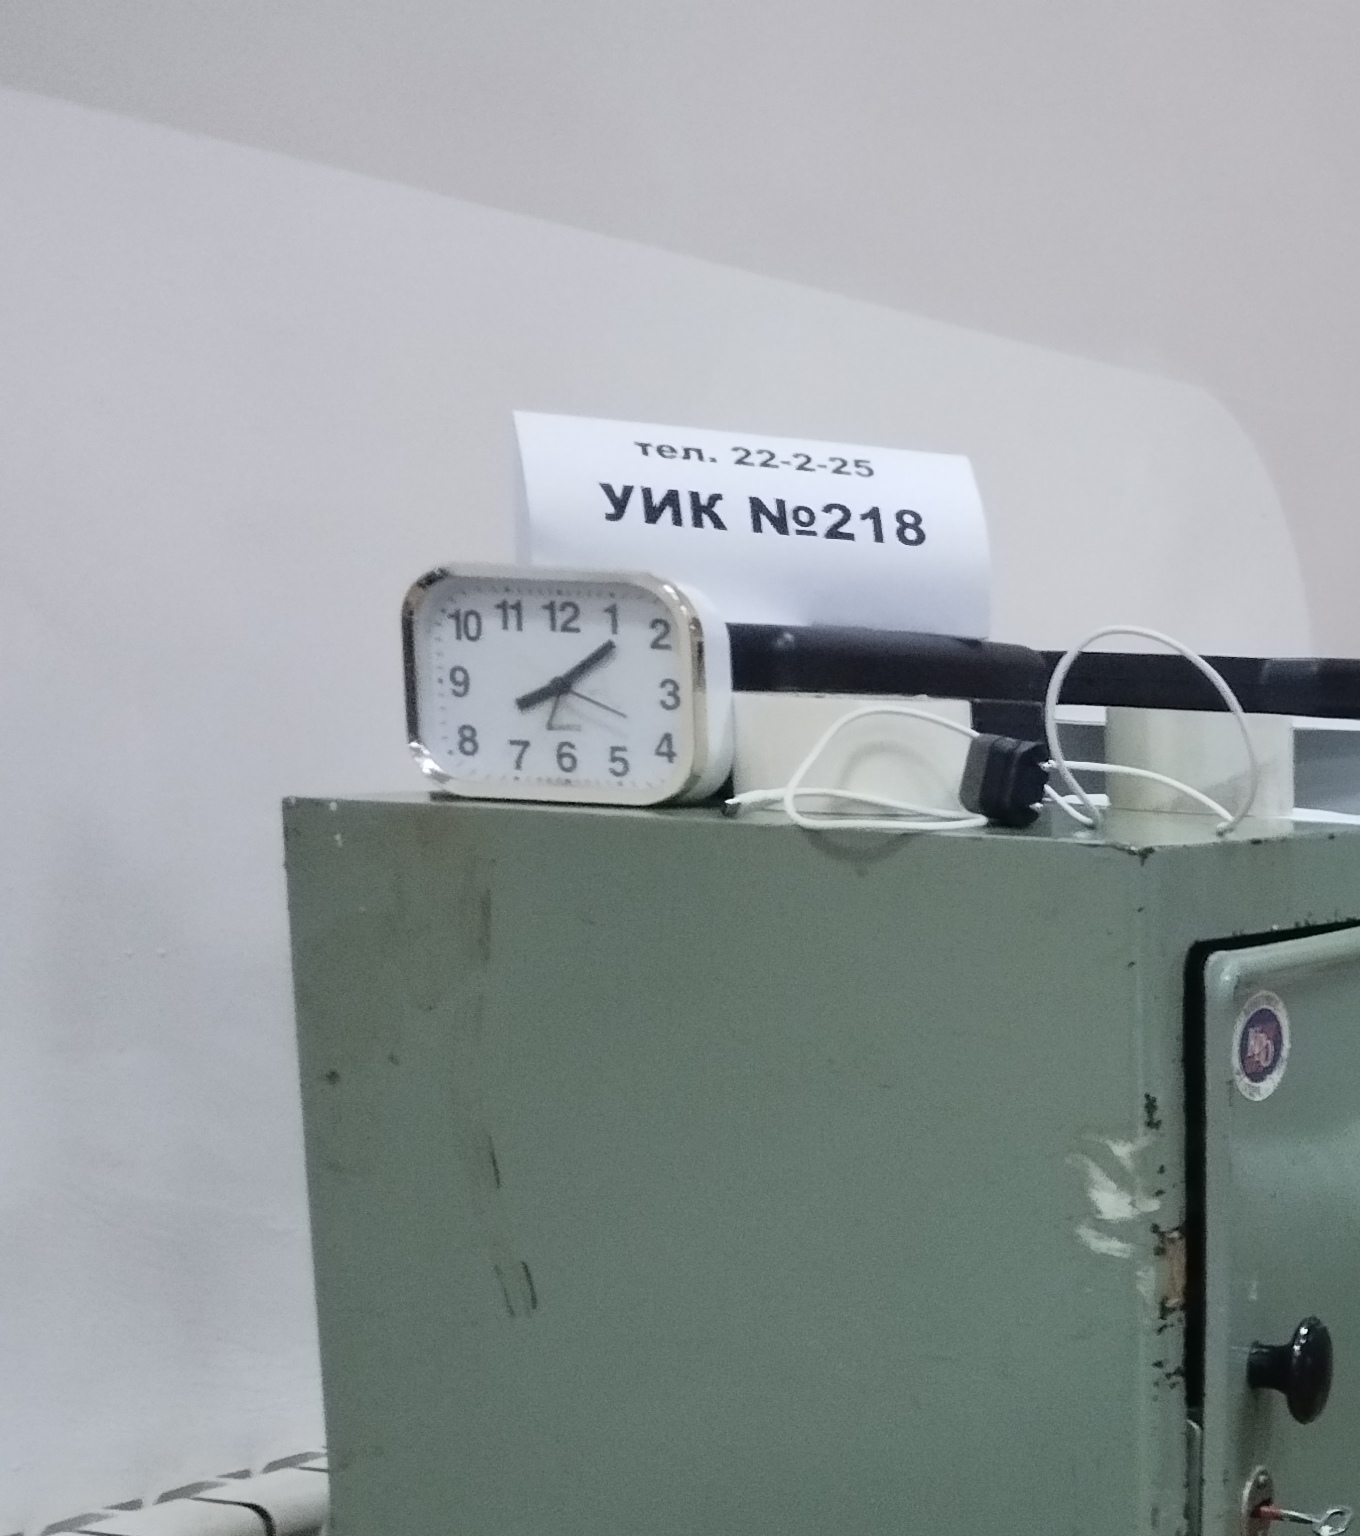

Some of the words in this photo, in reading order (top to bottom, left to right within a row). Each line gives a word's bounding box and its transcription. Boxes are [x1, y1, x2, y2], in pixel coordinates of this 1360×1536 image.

[634, 441, 718, 463] тел.
[731, 446, 875, 478] 22-2-25
[599, 482, 728, 531] УИК
[749, 496, 927, 547] №218
[448, 609, 482, 641] 10
[495, 599, 523, 632] 11
[542, 601, 581, 633] 12
[604, 604, 619, 635] 1
[650, 618, 672, 650] 2
[450, 665, 470, 697] 9
[659, 678, 681, 710] 3
[458, 724, 479, 756] 8
[508, 739, 531, 770] 7
[655, 732, 677, 763] 4
[556, 741, 577, 773] 6
[609, 746, 630, 777] 5
